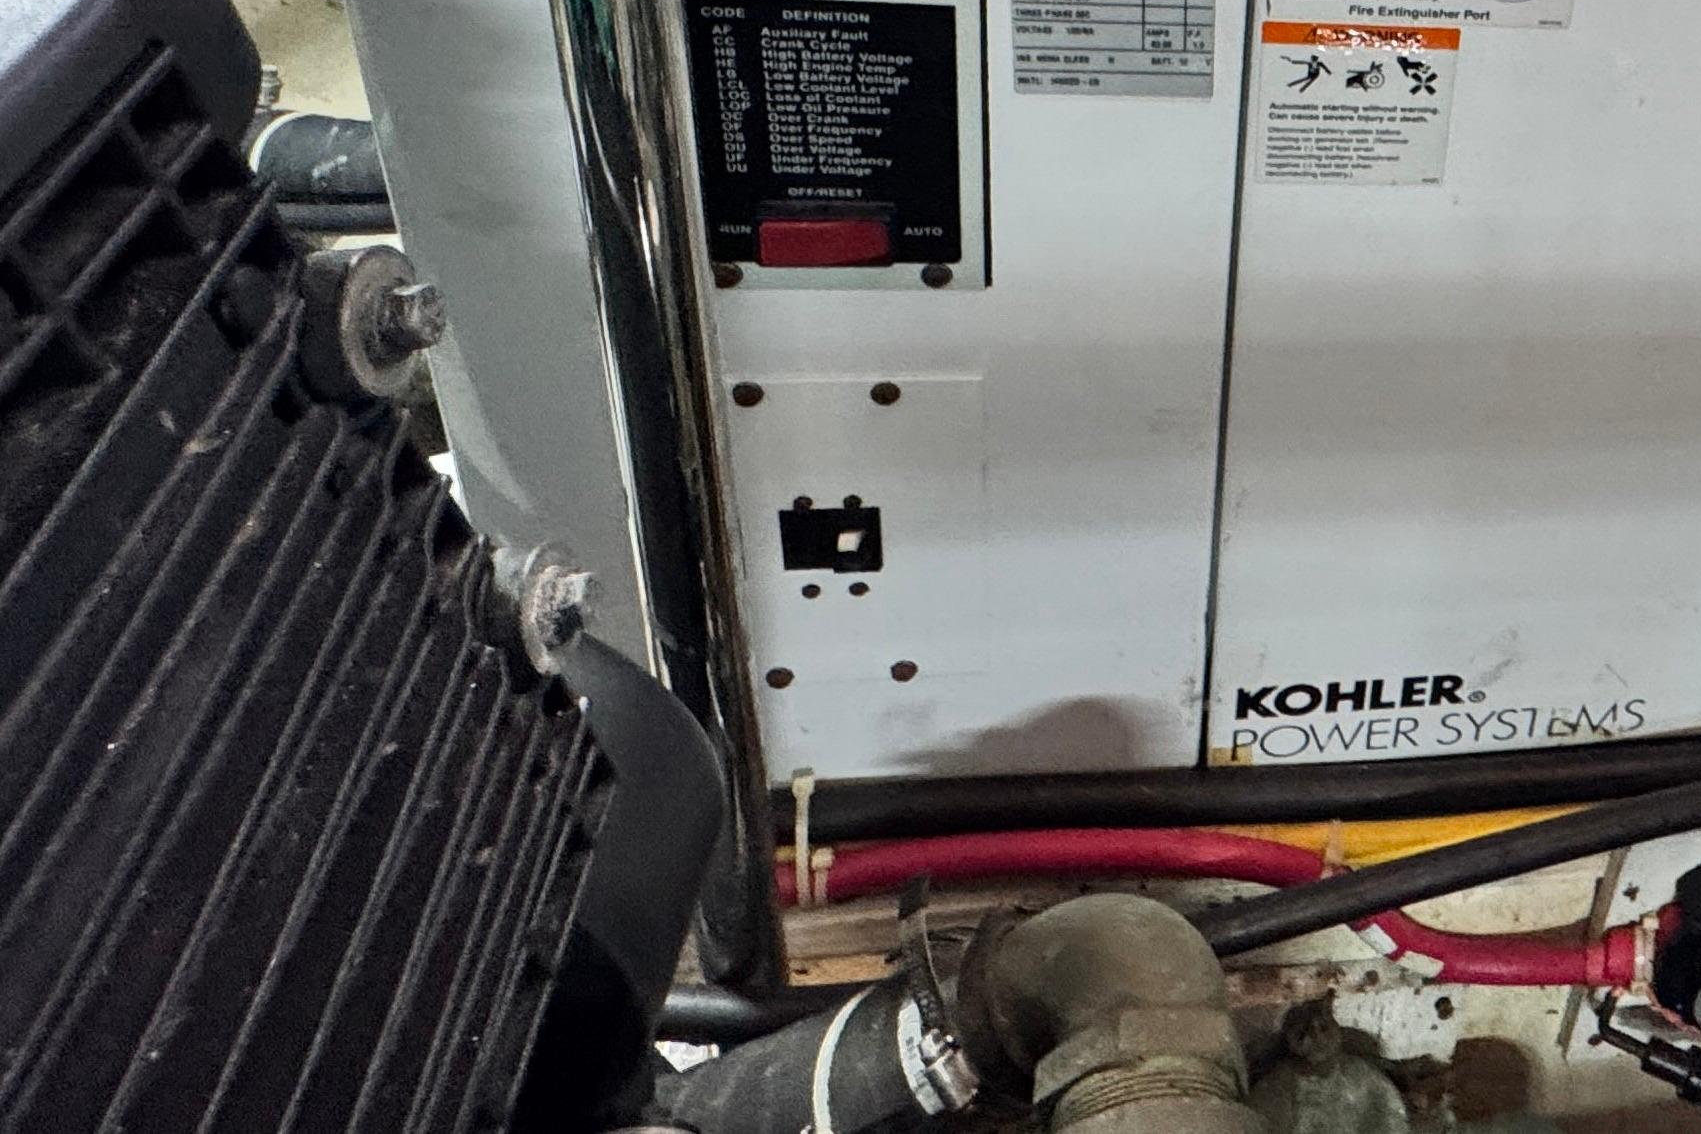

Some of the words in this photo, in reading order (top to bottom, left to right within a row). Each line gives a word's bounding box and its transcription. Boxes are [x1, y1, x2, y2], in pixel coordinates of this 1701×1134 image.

[700, 7, 745, 18] CODE
[782, 9, 870, 24] DEFINITION
[1348, 5, 1374, 18] Fire
[1377, 6, 1460, 21] Extinguisher
[1463, 8, 1491, 22] Port
[761, 26, 826, 42] Auxiliary
[832, 30, 869, 42] Fault
[713, 36, 736, 46] CC
[761, 38, 804, 49] Crank
[810, 40, 851, 52] Cycle
[761, 49, 796, 61] High
[801, 50, 854, 64] Battery
[859, 53, 913, 66] Voltage
[763, 60, 797, 72] High
[802, 61, 853, 74] Engine
[858, 63, 897, 76] Temp
[764, 71, 795, 81] Low
[800, 72, 852, 85] Battery
[856, 74, 910, 87] Voltage
[765, 82, 795, 92] Low
[800, 82, 856, 94] Coolant
[861, 84, 899, 95] Level
[825, 94, 881, 105] Coolant
[720, 101, 751, 111] LOP
[767, 102, 797, 113] Low
[802, 103, 822, 113] Oil
[827, 104, 891, 115] Pressure
[768, 113, 802, 123] Over
[806, 114, 849, 125] Crank
[1357, 115, 1384, 124] injury
[768, 123, 802, 133] Over
[807, 124, 882, 137] Frequency
[770, 133, 803, 143] Over
[808, 134, 853, 146] Speed
[770, 144, 804, 154] Over
[810, 145, 862, 156] Voltage
[771, 154, 814, 164] Under
[818, 155, 893, 168] Frequency
[772, 164, 815, 175] Under
[820, 165, 872, 177] Voltage
[788, 187, 863, 198] OFF/RESET
[904, 226, 943, 237] AUTO
[1230, 716, 1419, 762] POWER
[1436, 698, 1647, 746] SYSTEMS
